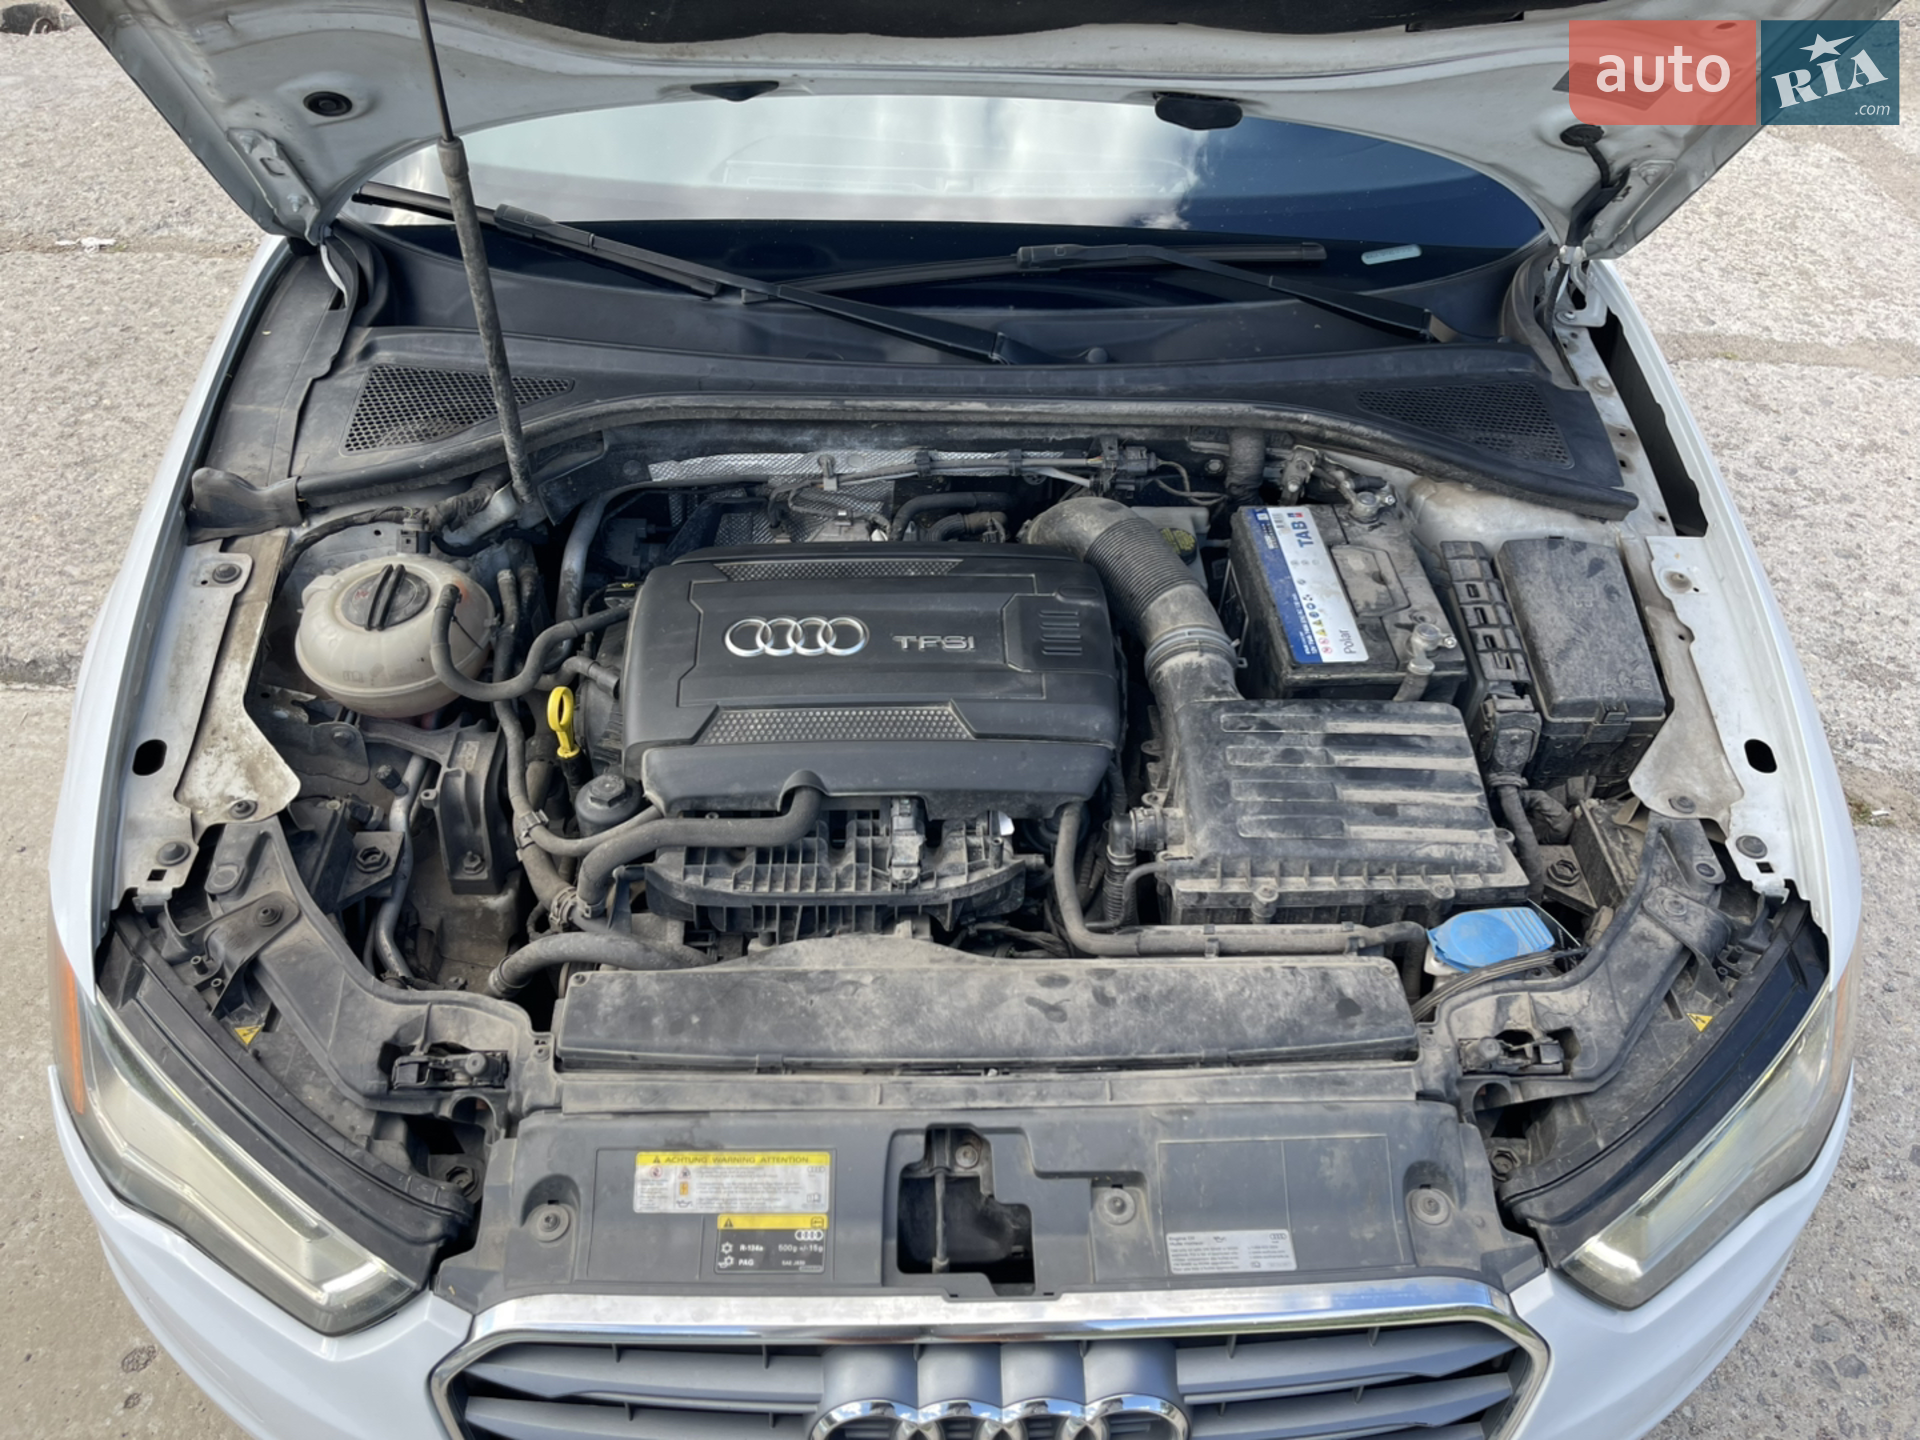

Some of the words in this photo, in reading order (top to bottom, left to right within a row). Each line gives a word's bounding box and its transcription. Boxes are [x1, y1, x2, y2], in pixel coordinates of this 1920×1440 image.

[1291, 520, 1314, 548] TAB
[892, 634, 976, 652] TFSI
[1338, 628, 1357, 655] Polar
[664, 1156, 708, 1164] ACHTUNG
[712, 1156, 756, 1164] WARNING
[759, 1156, 810, 1164] ATTENTION
[738, 1258, 754, 1267] PAG
